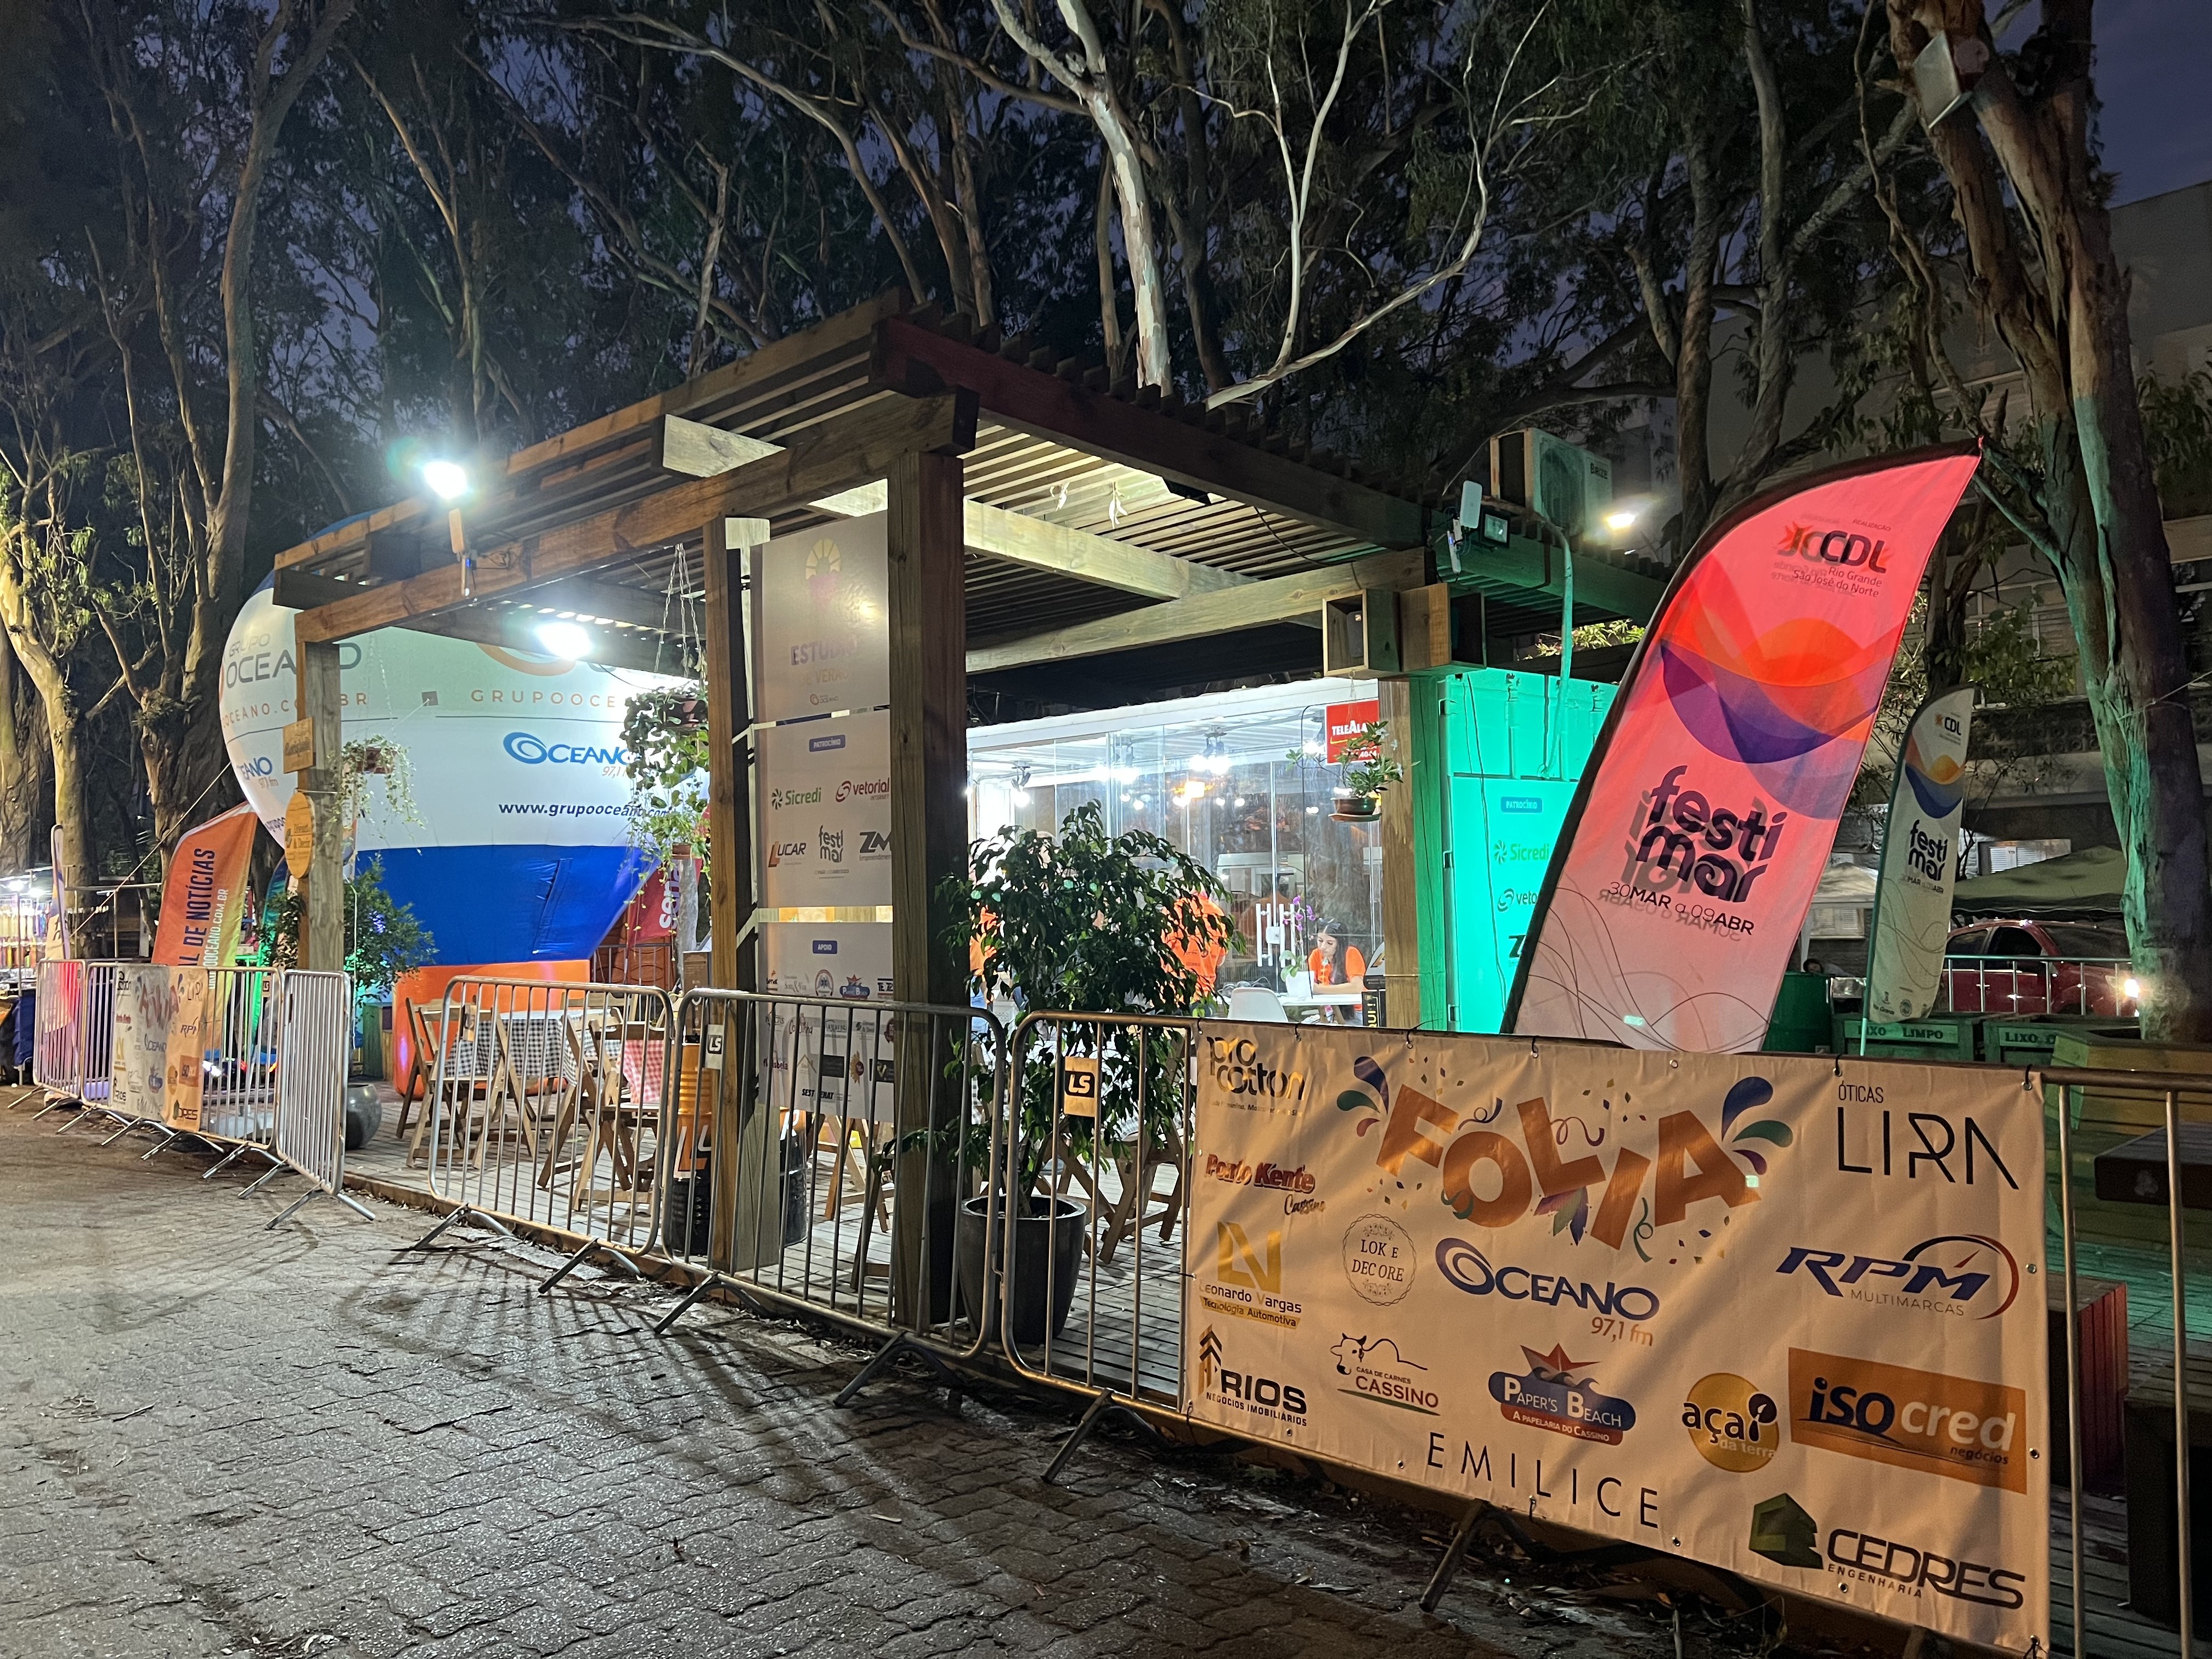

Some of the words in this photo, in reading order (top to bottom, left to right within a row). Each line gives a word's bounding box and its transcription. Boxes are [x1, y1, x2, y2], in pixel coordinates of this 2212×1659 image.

[1820, 531, 1887, 574] CDL
[1793, 569, 1811, 582] São
[1812, 575, 1835, 587] José
[1836, 578, 1848, 590] do
[1850, 583, 1879, 598] Norte
[1829, 566, 1844, 577] Rio
[1847, 571, 1882, 588] Grande
[229, 633, 270, 657] GRUPO
[1944, 716, 1961, 736] CDL
[785, 787, 822, 806] Sicredi
[853, 777, 890, 795] vetorial
[1646, 765, 1788, 862] festi
[818, 825, 844, 848] festi
[1909, 819, 1948, 862] festi
[820, 845, 844, 864] mar
[1510, 843, 1550, 861] Sicredi
[1635, 825, 1769, 904] mar
[1908, 848, 1945, 881] mar
[185, 848, 216, 921] NOTÍCIAS
[1607, 881, 1672, 910] 30MAR
[1675, 901, 1687, 914] a
[1691, 904, 1755, 936] 09ABR
[183, 926, 207, 947] DE
[817, 943, 833, 951] APOIO
[1903, 1026, 1944, 1040] LIMPO
[2005, 1031, 2038, 1043] LIXO
[1206, 1036, 1256, 1076] pro
[802, 1088, 815, 1097] SEST
[821, 1091, 834, 1100] ENAT
[1068, 1074, 1091, 1094] LS
[1217, 1063, 1306, 1101] cotton
[1838, 1079, 1884, 1104] ÓTICAS
[1254, 1162, 1316, 1194] Kente
[1376, 1084, 1762, 1251] FOLIA
[1361, 1239, 1387, 1256] LOK
[1391, 1247, 1398, 1258] E
[1434, 1237, 1660, 1321] OCEANO
[1775, 1246, 1990, 1302] RPM
[1199, 1279, 1252, 1302] Leonardo
[1256, 1291, 1302, 1313] Vargas
[1850, 1289, 1965, 1317] MULTIMARCAS
[1203, 1297, 1244, 1315] Tecnologia
[1247, 1308, 1296, 1327] Automotiva
[1590, 1318, 1625, 1343] 97,1
[1629, 1323, 1654, 1347] fm
[1356, 1366, 1373, 1375] CASA
[1384, 1373, 1412, 1385] CARNES
[1221, 1369, 1308, 1415] RIOS
[1356, 1375, 1438, 1408] CASSINO
[1206, 1392, 1244, 1410] NEGOCIOS
[1247, 1403, 1307, 1426] IMOBILIÁRIOS
[1567, 1391, 1622, 1427] BEACH
[1513, 1410, 1521, 1420] A
[1521, 1415, 1561, 1431] PAPELARIA
[1573, 1425, 1611, 1442] CASSINO
[1719, 1436, 1738, 1451] da
[1741, 1441, 1776, 1459] terra
[1950, 1444, 2010, 1466] negócios
[1427, 1431, 1659, 1529] EMILICE
[1827, 1528, 2025, 1610] CEDRES
[1827, 1564, 1922, 1599] ENGENHARIA
